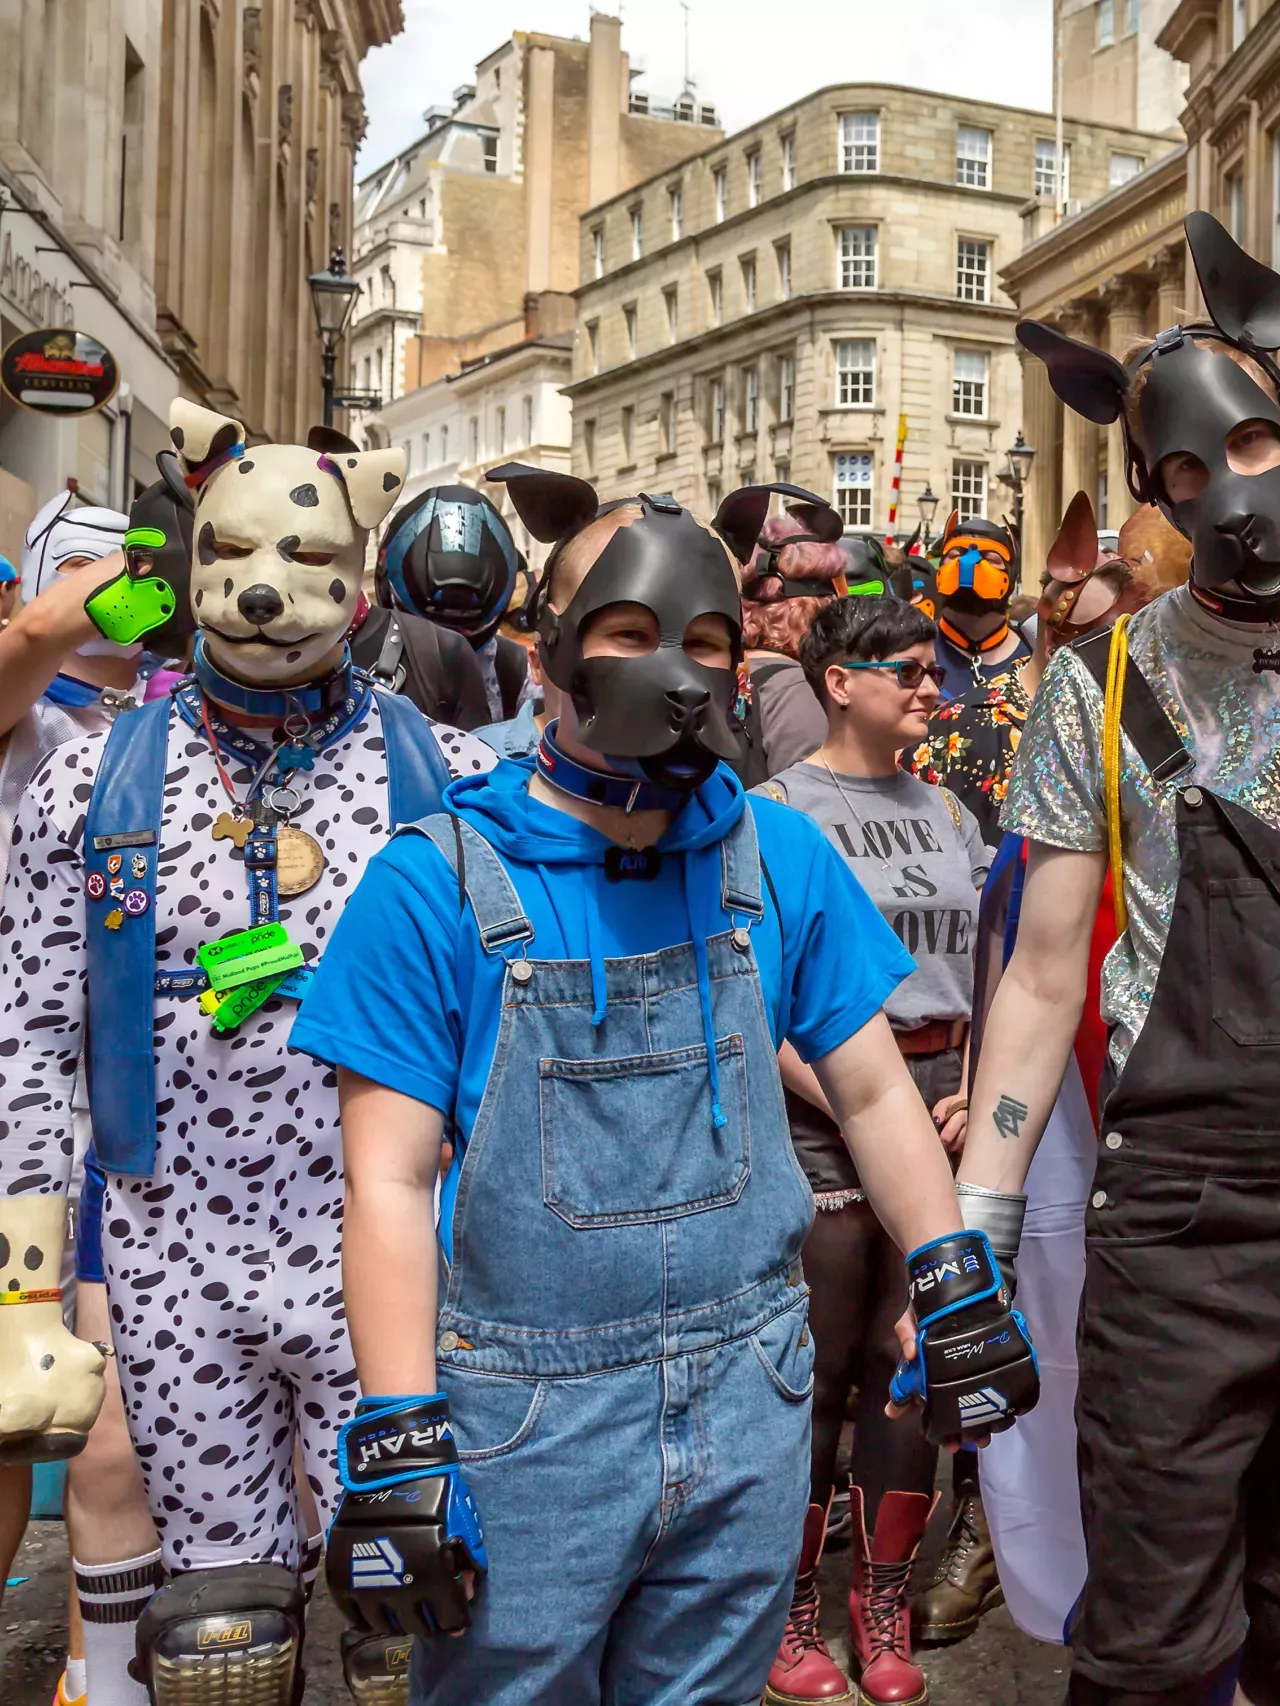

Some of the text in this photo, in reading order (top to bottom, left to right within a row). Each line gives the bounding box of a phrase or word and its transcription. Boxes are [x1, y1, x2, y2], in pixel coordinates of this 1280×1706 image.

[832, 819, 943, 859] LOVE
[251, 930, 275, 945] pride
[893, 909, 972, 955] OVE
[222, 968, 245, 978] Midland
[246, 964, 260, 973] Pups
[232, 981, 267, 1018] pride
[908, 1254, 981, 1300] EMRA
[407, 1414, 448, 1429] ANCE
[358, 1420, 454, 1464] MRAH
